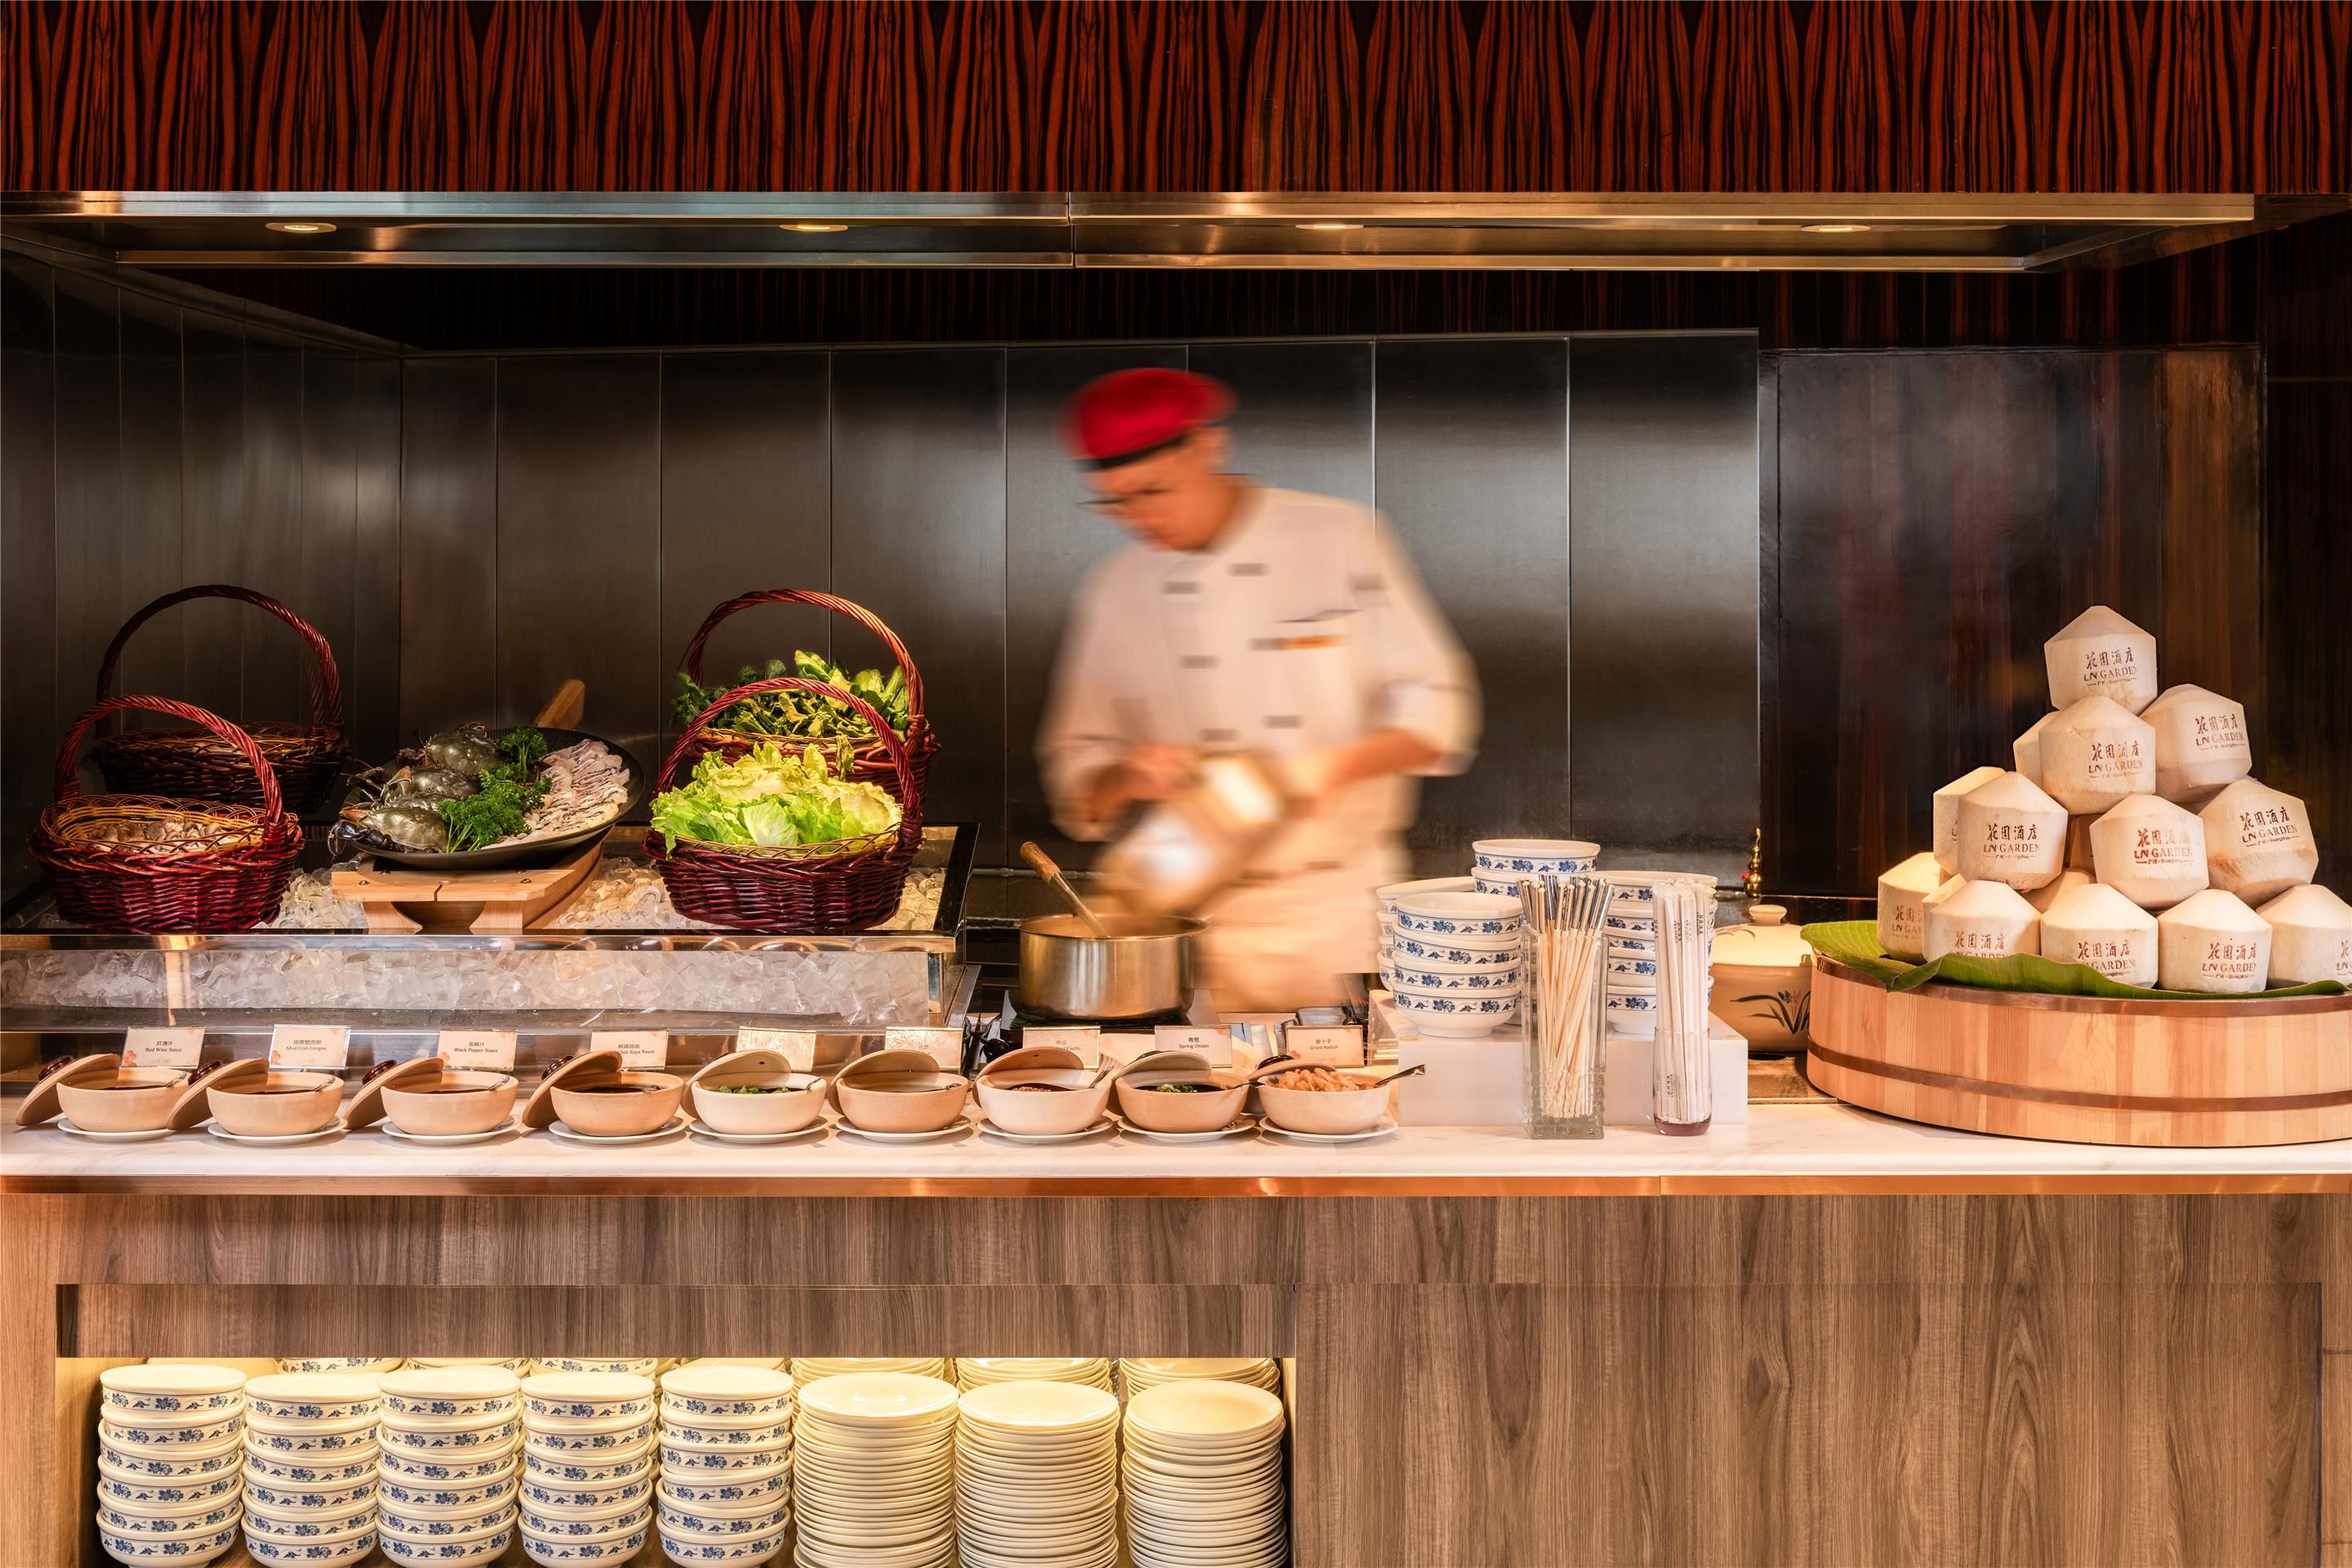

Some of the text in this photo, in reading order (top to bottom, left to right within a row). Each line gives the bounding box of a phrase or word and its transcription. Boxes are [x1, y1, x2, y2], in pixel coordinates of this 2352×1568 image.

[2083, 671, 2098, 682] LN
[2195, 732, 2245, 746] LN GARDEN
[2088, 760, 2143, 773] LN GARDEN
[2242, 825, 2298, 844] LN GARDEN
[1983, 844, 2040, 853] LN GARDEN
[2134, 848, 2193, 859] LN GARDEN
[1891, 923, 1903, 932] LN
[2091, 959, 2136, 970] GARDEN
[2202, 963, 2218, 972] LN
